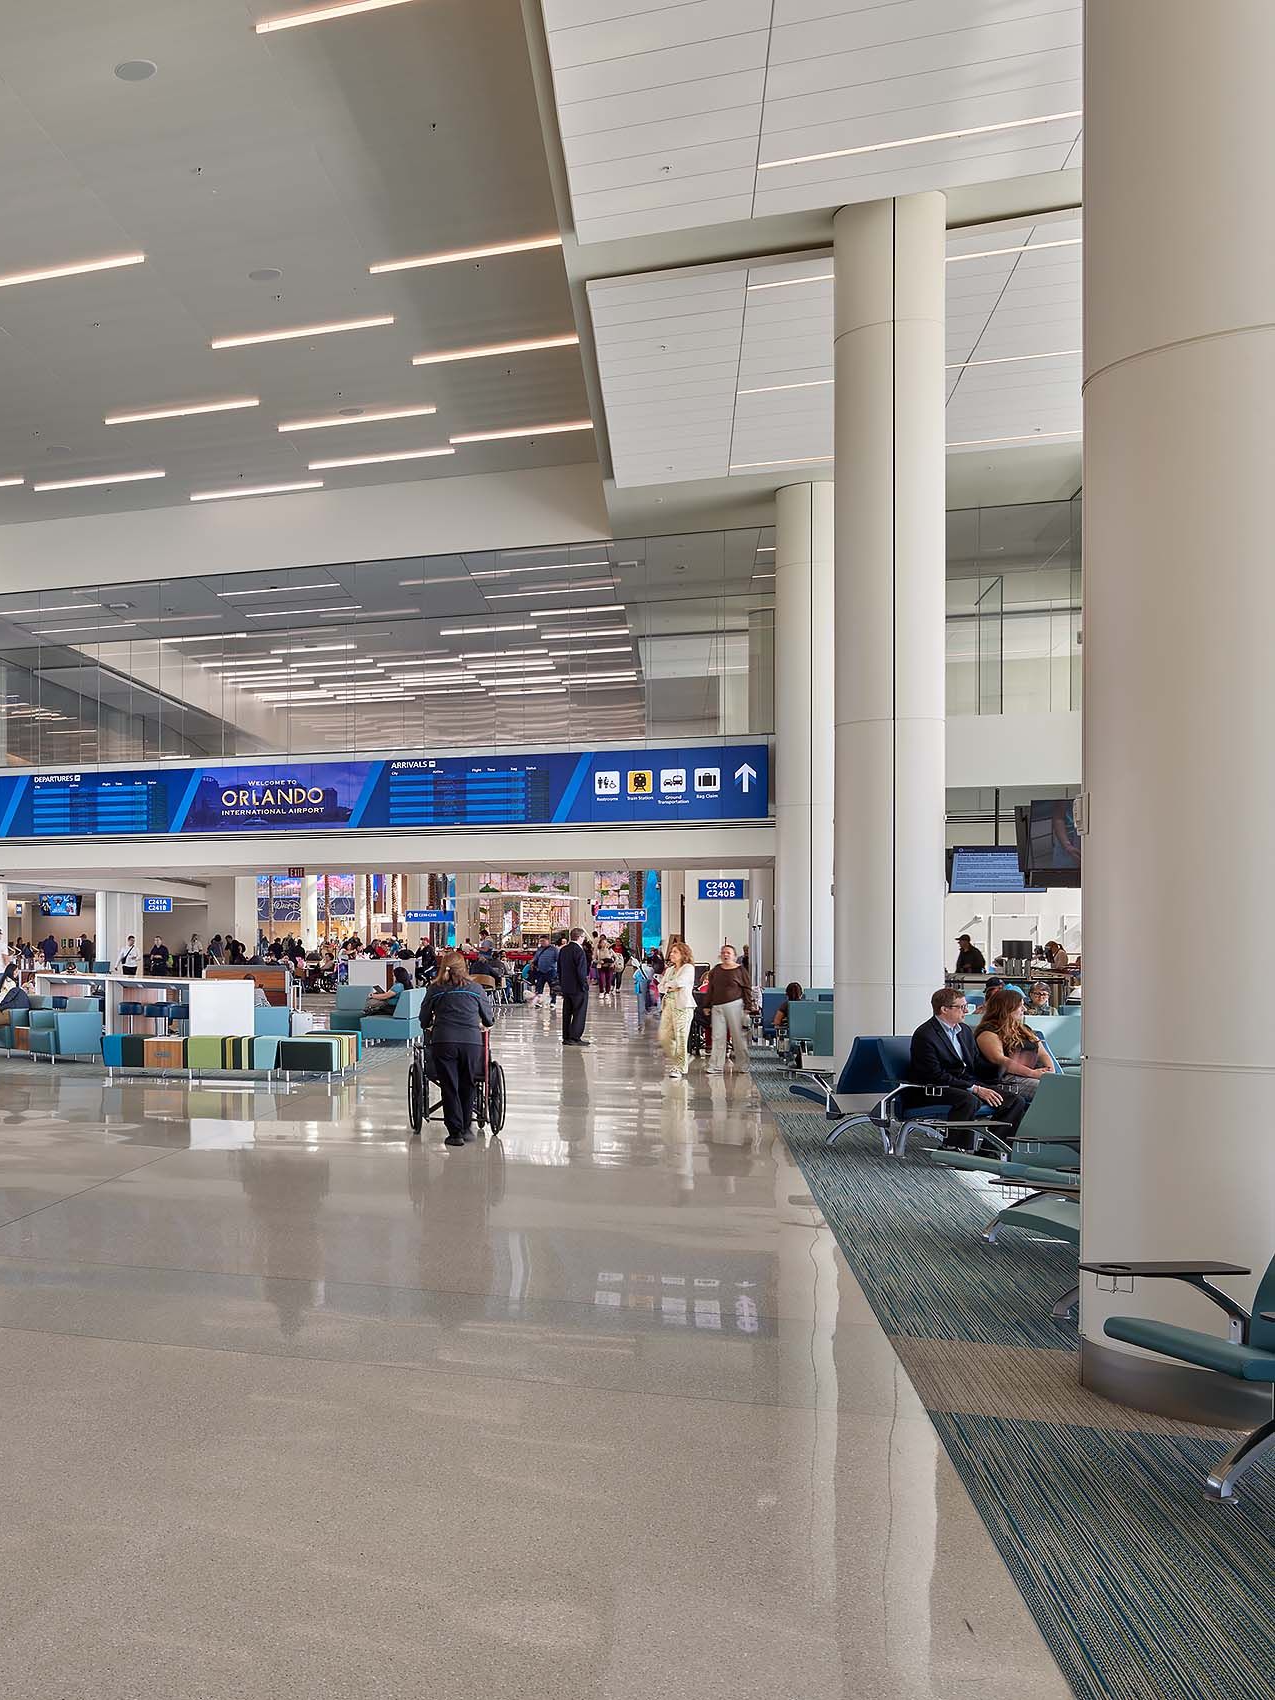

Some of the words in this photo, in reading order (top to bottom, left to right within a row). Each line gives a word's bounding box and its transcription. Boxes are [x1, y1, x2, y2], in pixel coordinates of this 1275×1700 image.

[391, 761, 428, 769] ARRIVALS
[33, 775, 74, 783] DEPARTURES
[221, 787, 323, 807] ORLANDO
[221, 808, 286, 816] INTERNATIONAL
[290, 868, 303, 877] EXIT
[706, 890, 735, 898] C240B
